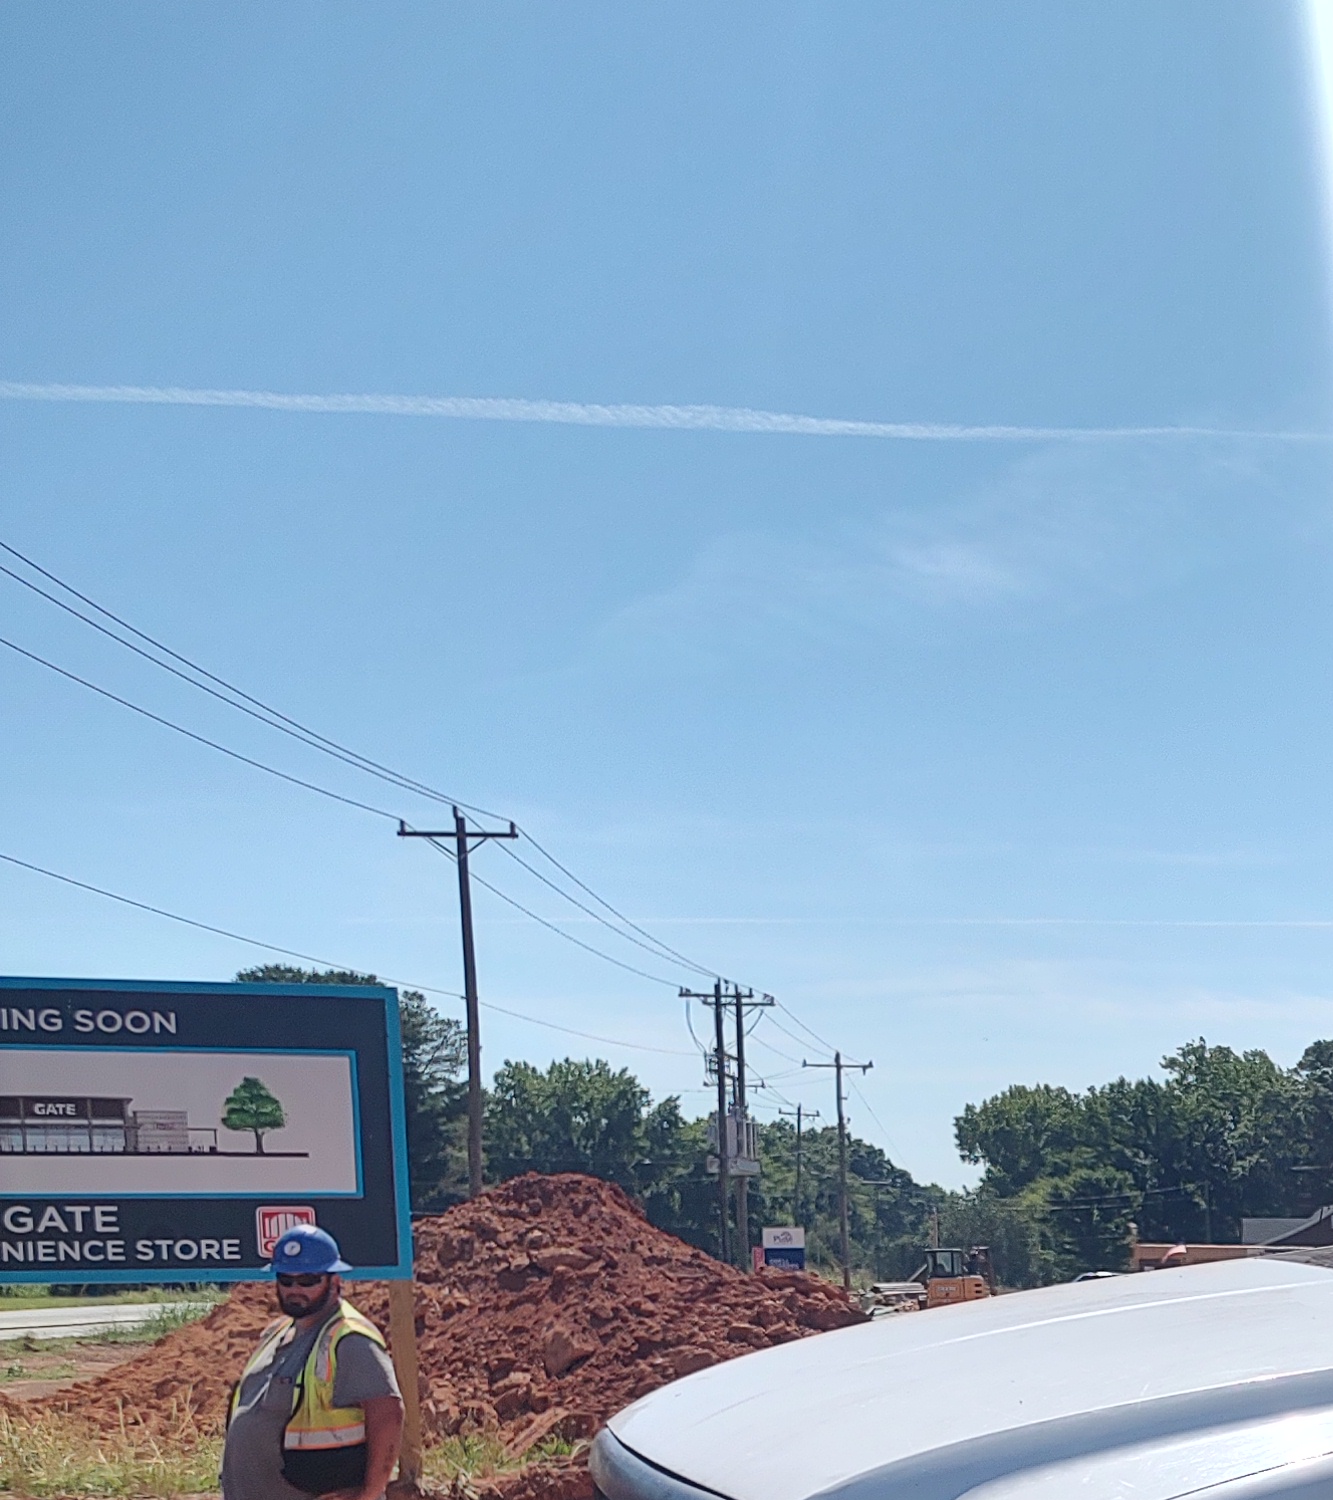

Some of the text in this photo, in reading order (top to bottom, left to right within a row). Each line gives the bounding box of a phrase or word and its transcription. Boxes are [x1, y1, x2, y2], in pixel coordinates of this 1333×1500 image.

[74, 1009, 177, 1035] SOON
[34, 1103, 77, 1116] GATE
[4, 1205, 120, 1233] GATE
[1, 1240, 126, 1262] NIENCE
[135, 1239, 242, 1261] STORE
